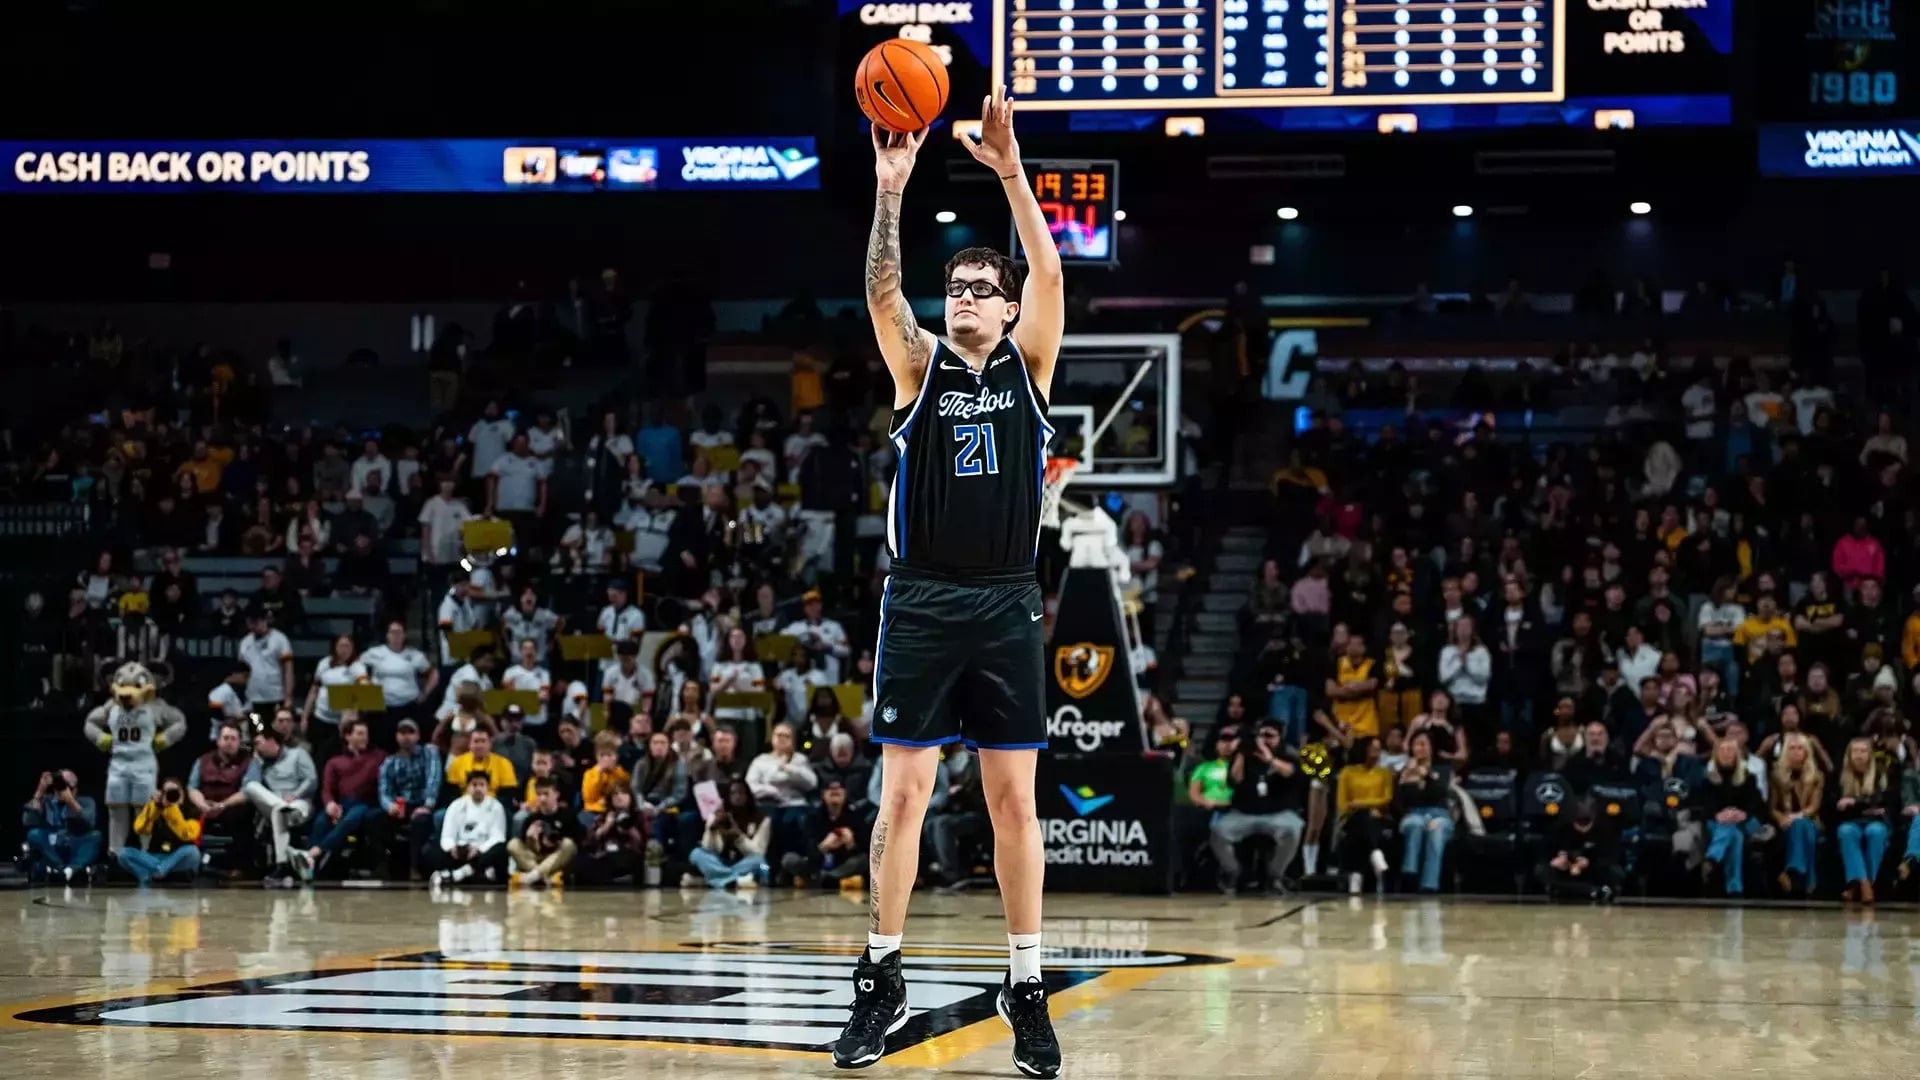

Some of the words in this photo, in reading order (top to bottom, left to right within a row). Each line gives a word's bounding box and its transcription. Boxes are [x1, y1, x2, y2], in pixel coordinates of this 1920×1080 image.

[860, 3, 916, 25] CASH
[917, 2, 973, 24] BACK
[1628, 9, 1663, 31] OR
[1604, 30, 1685, 54] POINTS
[1809, 71, 1896, 105] 1980
[1805, 129, 1901, 152] VIRGINIA
[14, 152, 101, 182] CASH
[108, 152, 192, 182] BACK
[197, 152, 245, 182] OR
[251, 151, 370, 182] POINTS
[1805, 149, 1858, 168] Credit
[1860, 148, 1912, 167] Union
[1072, 173, 1105, 200] 33
[953, 422, 999, 477] 21
[1046, 704, 1126, 751] Kroger
[1041, 818, 1148, 846] IRGINIA
[1045, 846, 1083, 865] edit
